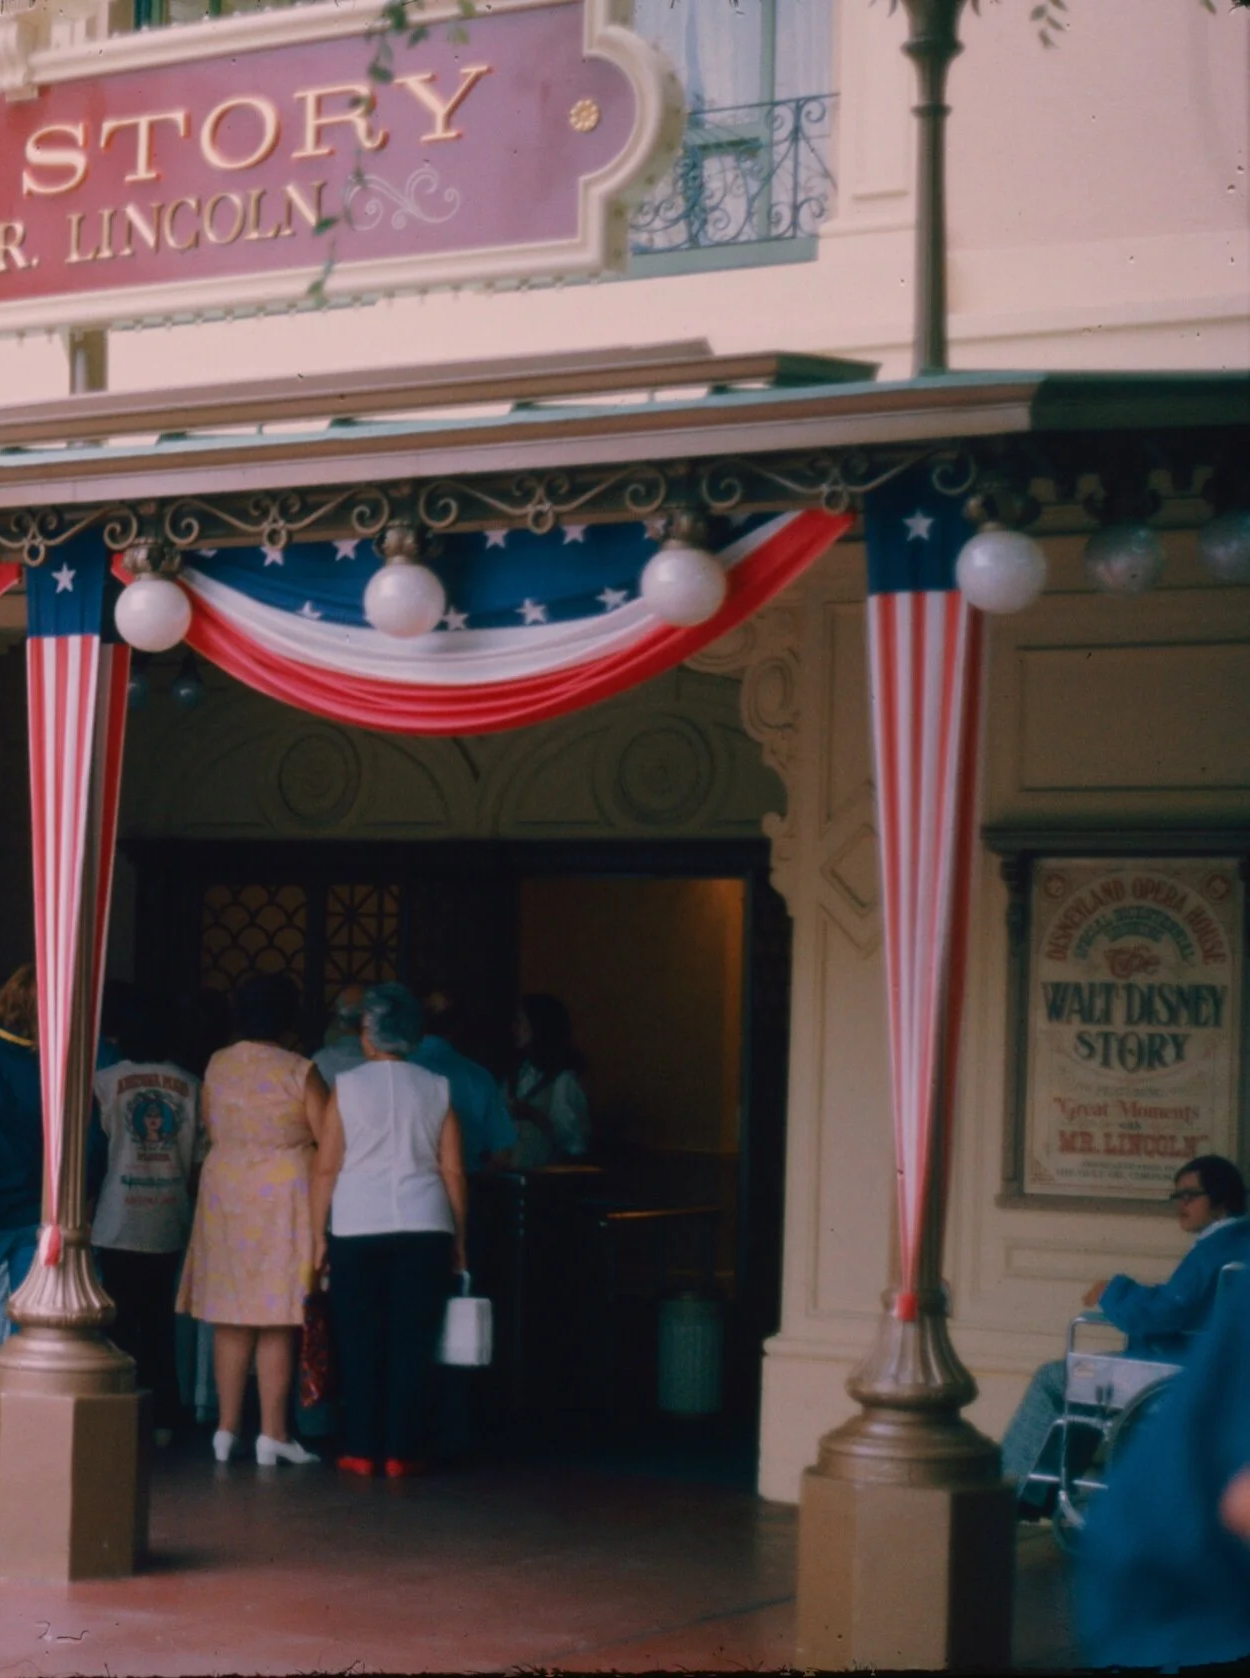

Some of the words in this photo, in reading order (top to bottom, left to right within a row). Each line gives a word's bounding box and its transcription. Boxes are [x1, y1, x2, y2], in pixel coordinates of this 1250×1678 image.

[22, 65, 493, 199] STORY
[65, 180, 332, 264] LINCOLN
[1045, 877, 1125, 962] DISNEYLAND
[1131, 876, 1189, 915] OPERA
[1183, 905, 1227, 965] HOUSE
[1040, 981, 1116, 1025] WALT
[1122, 982, 1228, 1028] DISNEY
[1075, 1030, 1190, 1073] STORY
